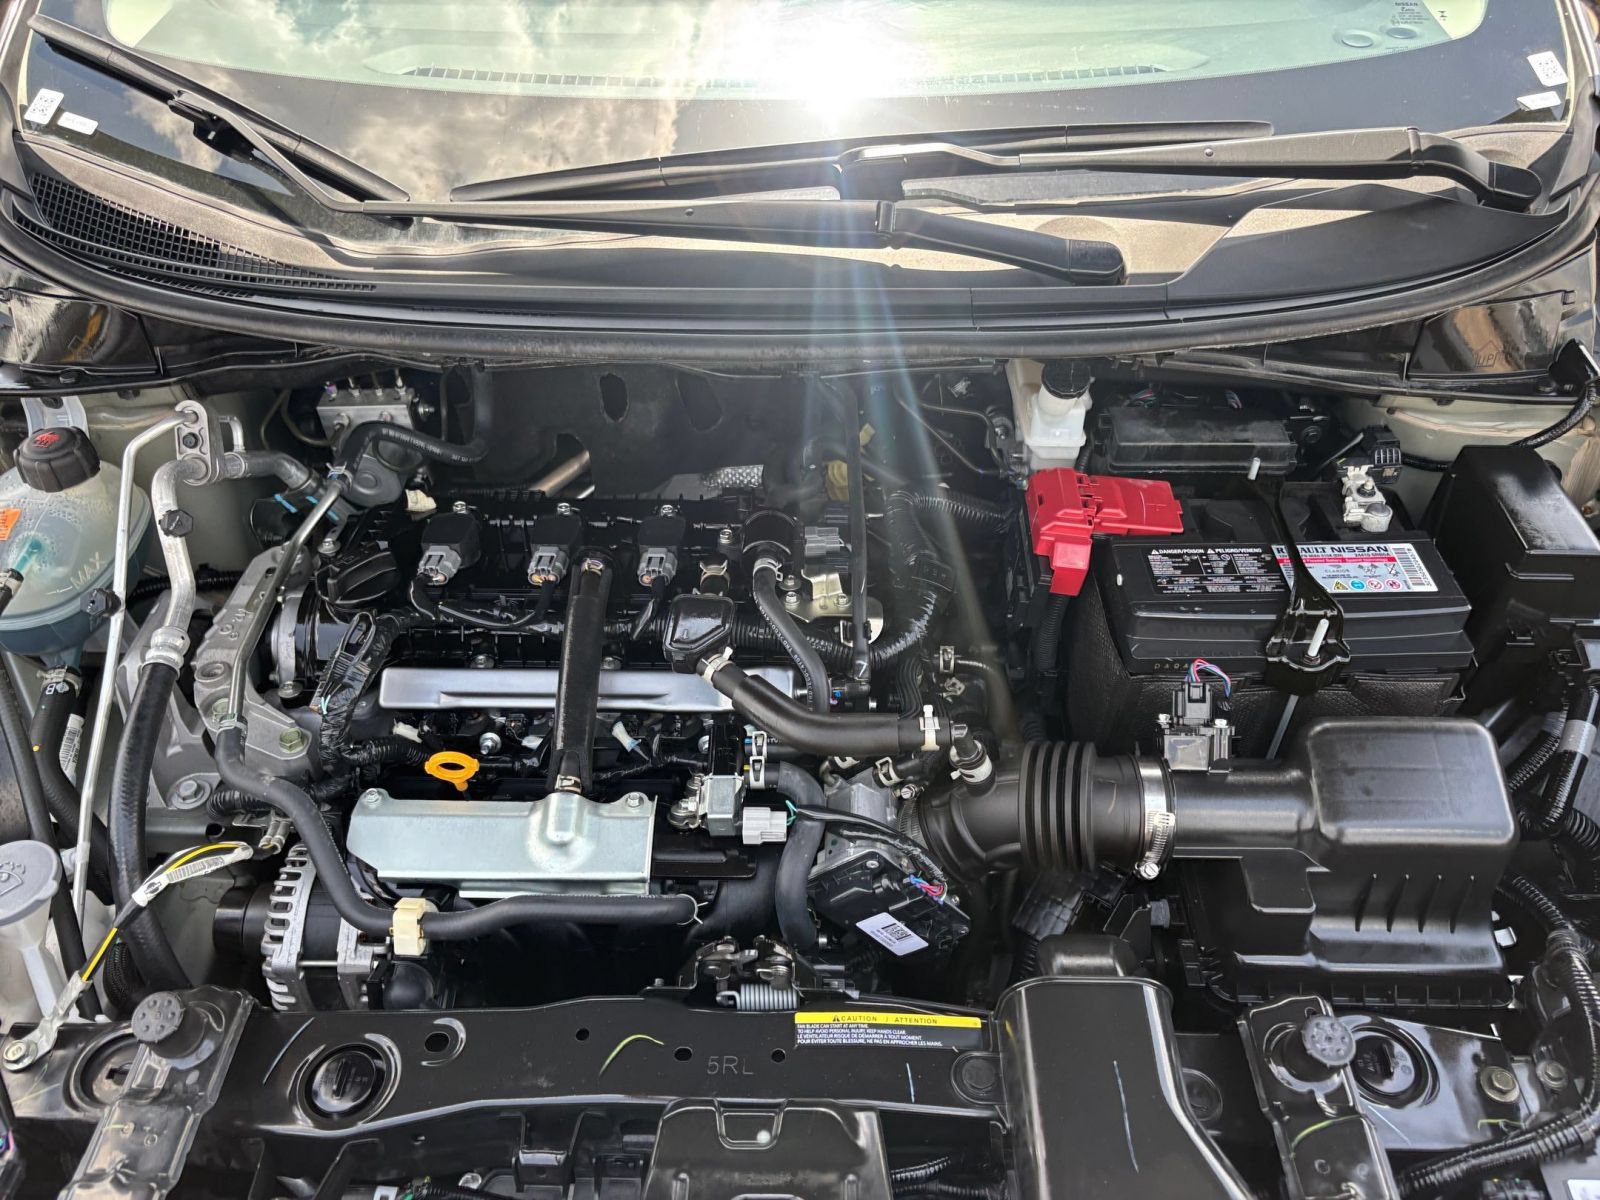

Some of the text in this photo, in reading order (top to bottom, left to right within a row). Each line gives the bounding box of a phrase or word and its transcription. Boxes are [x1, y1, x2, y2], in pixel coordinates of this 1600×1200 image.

[1331, 545, 1389, 553] NISSAN
[70, 551, 105, 590] MAX
[706, 1056, 754, 1075] 5RL
